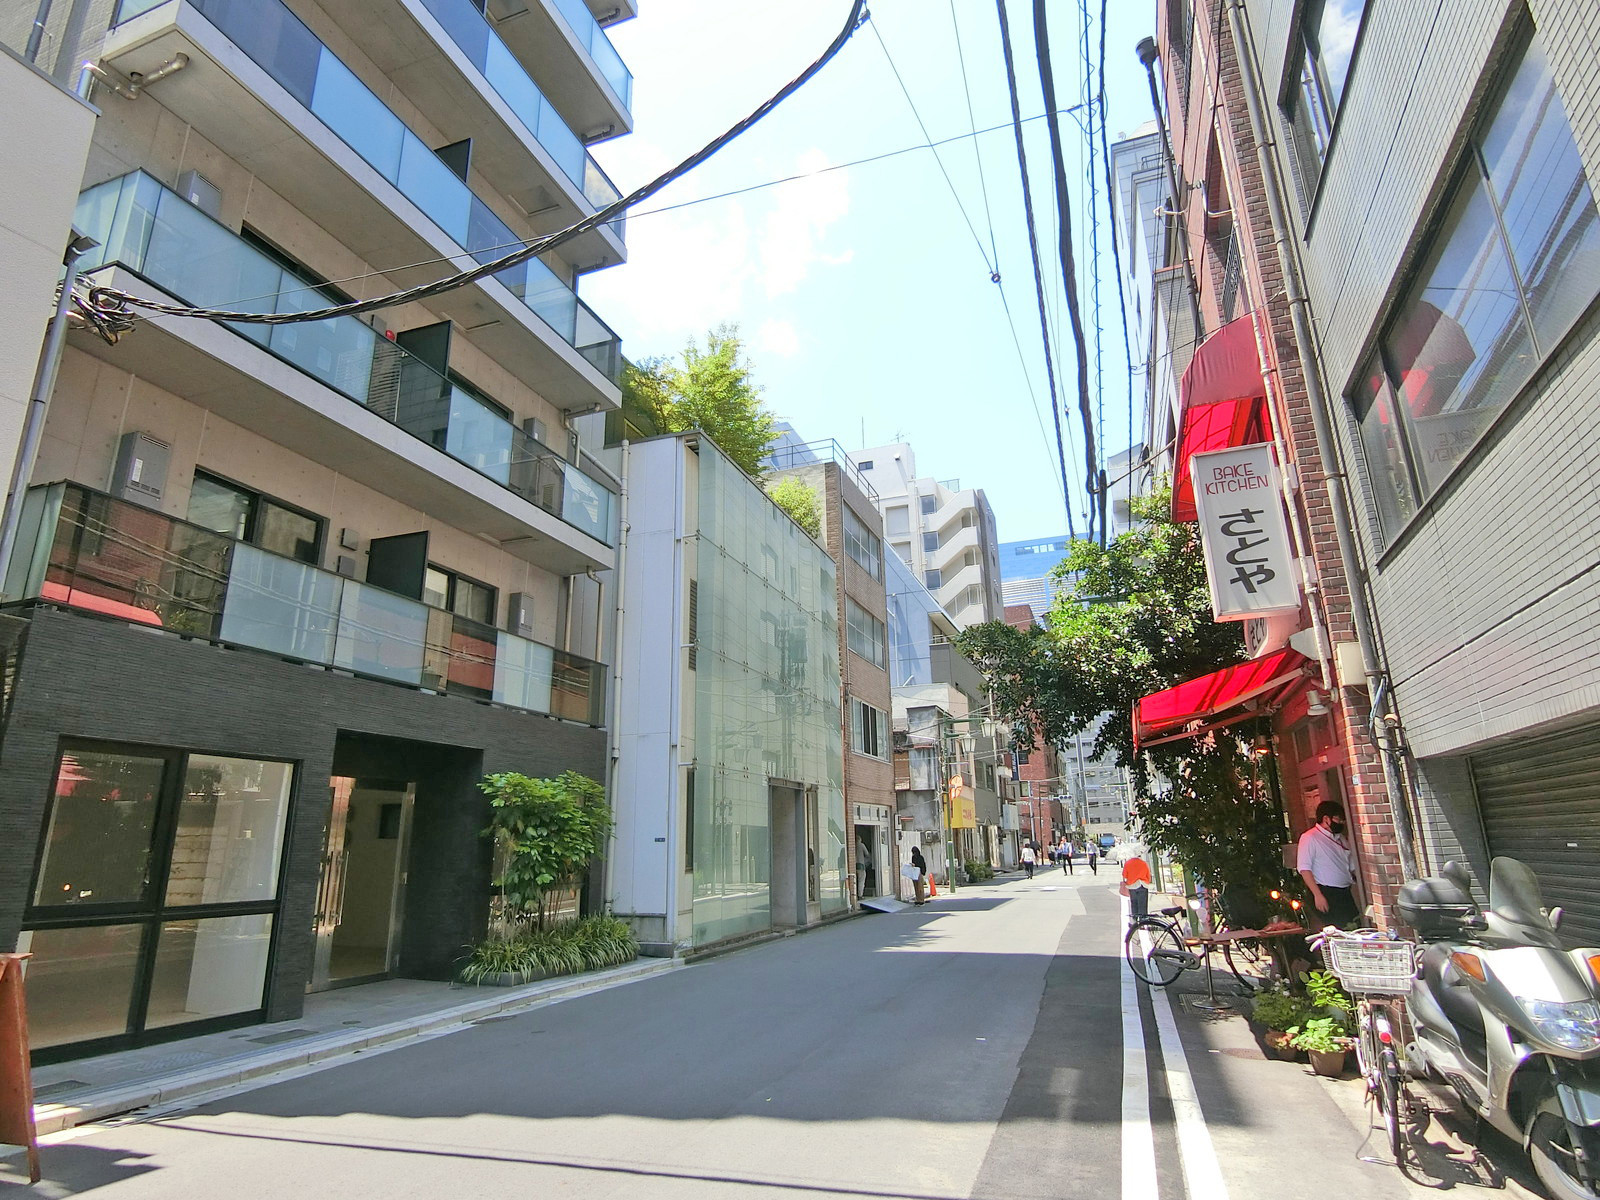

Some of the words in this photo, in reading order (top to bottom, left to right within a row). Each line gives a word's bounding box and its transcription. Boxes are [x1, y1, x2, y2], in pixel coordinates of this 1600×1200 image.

[1213, 462, 1254, 481] BAKE
[1205, 474, 1269, 495] KITCHEN
[1218, 508, 1276, 594] さとや
